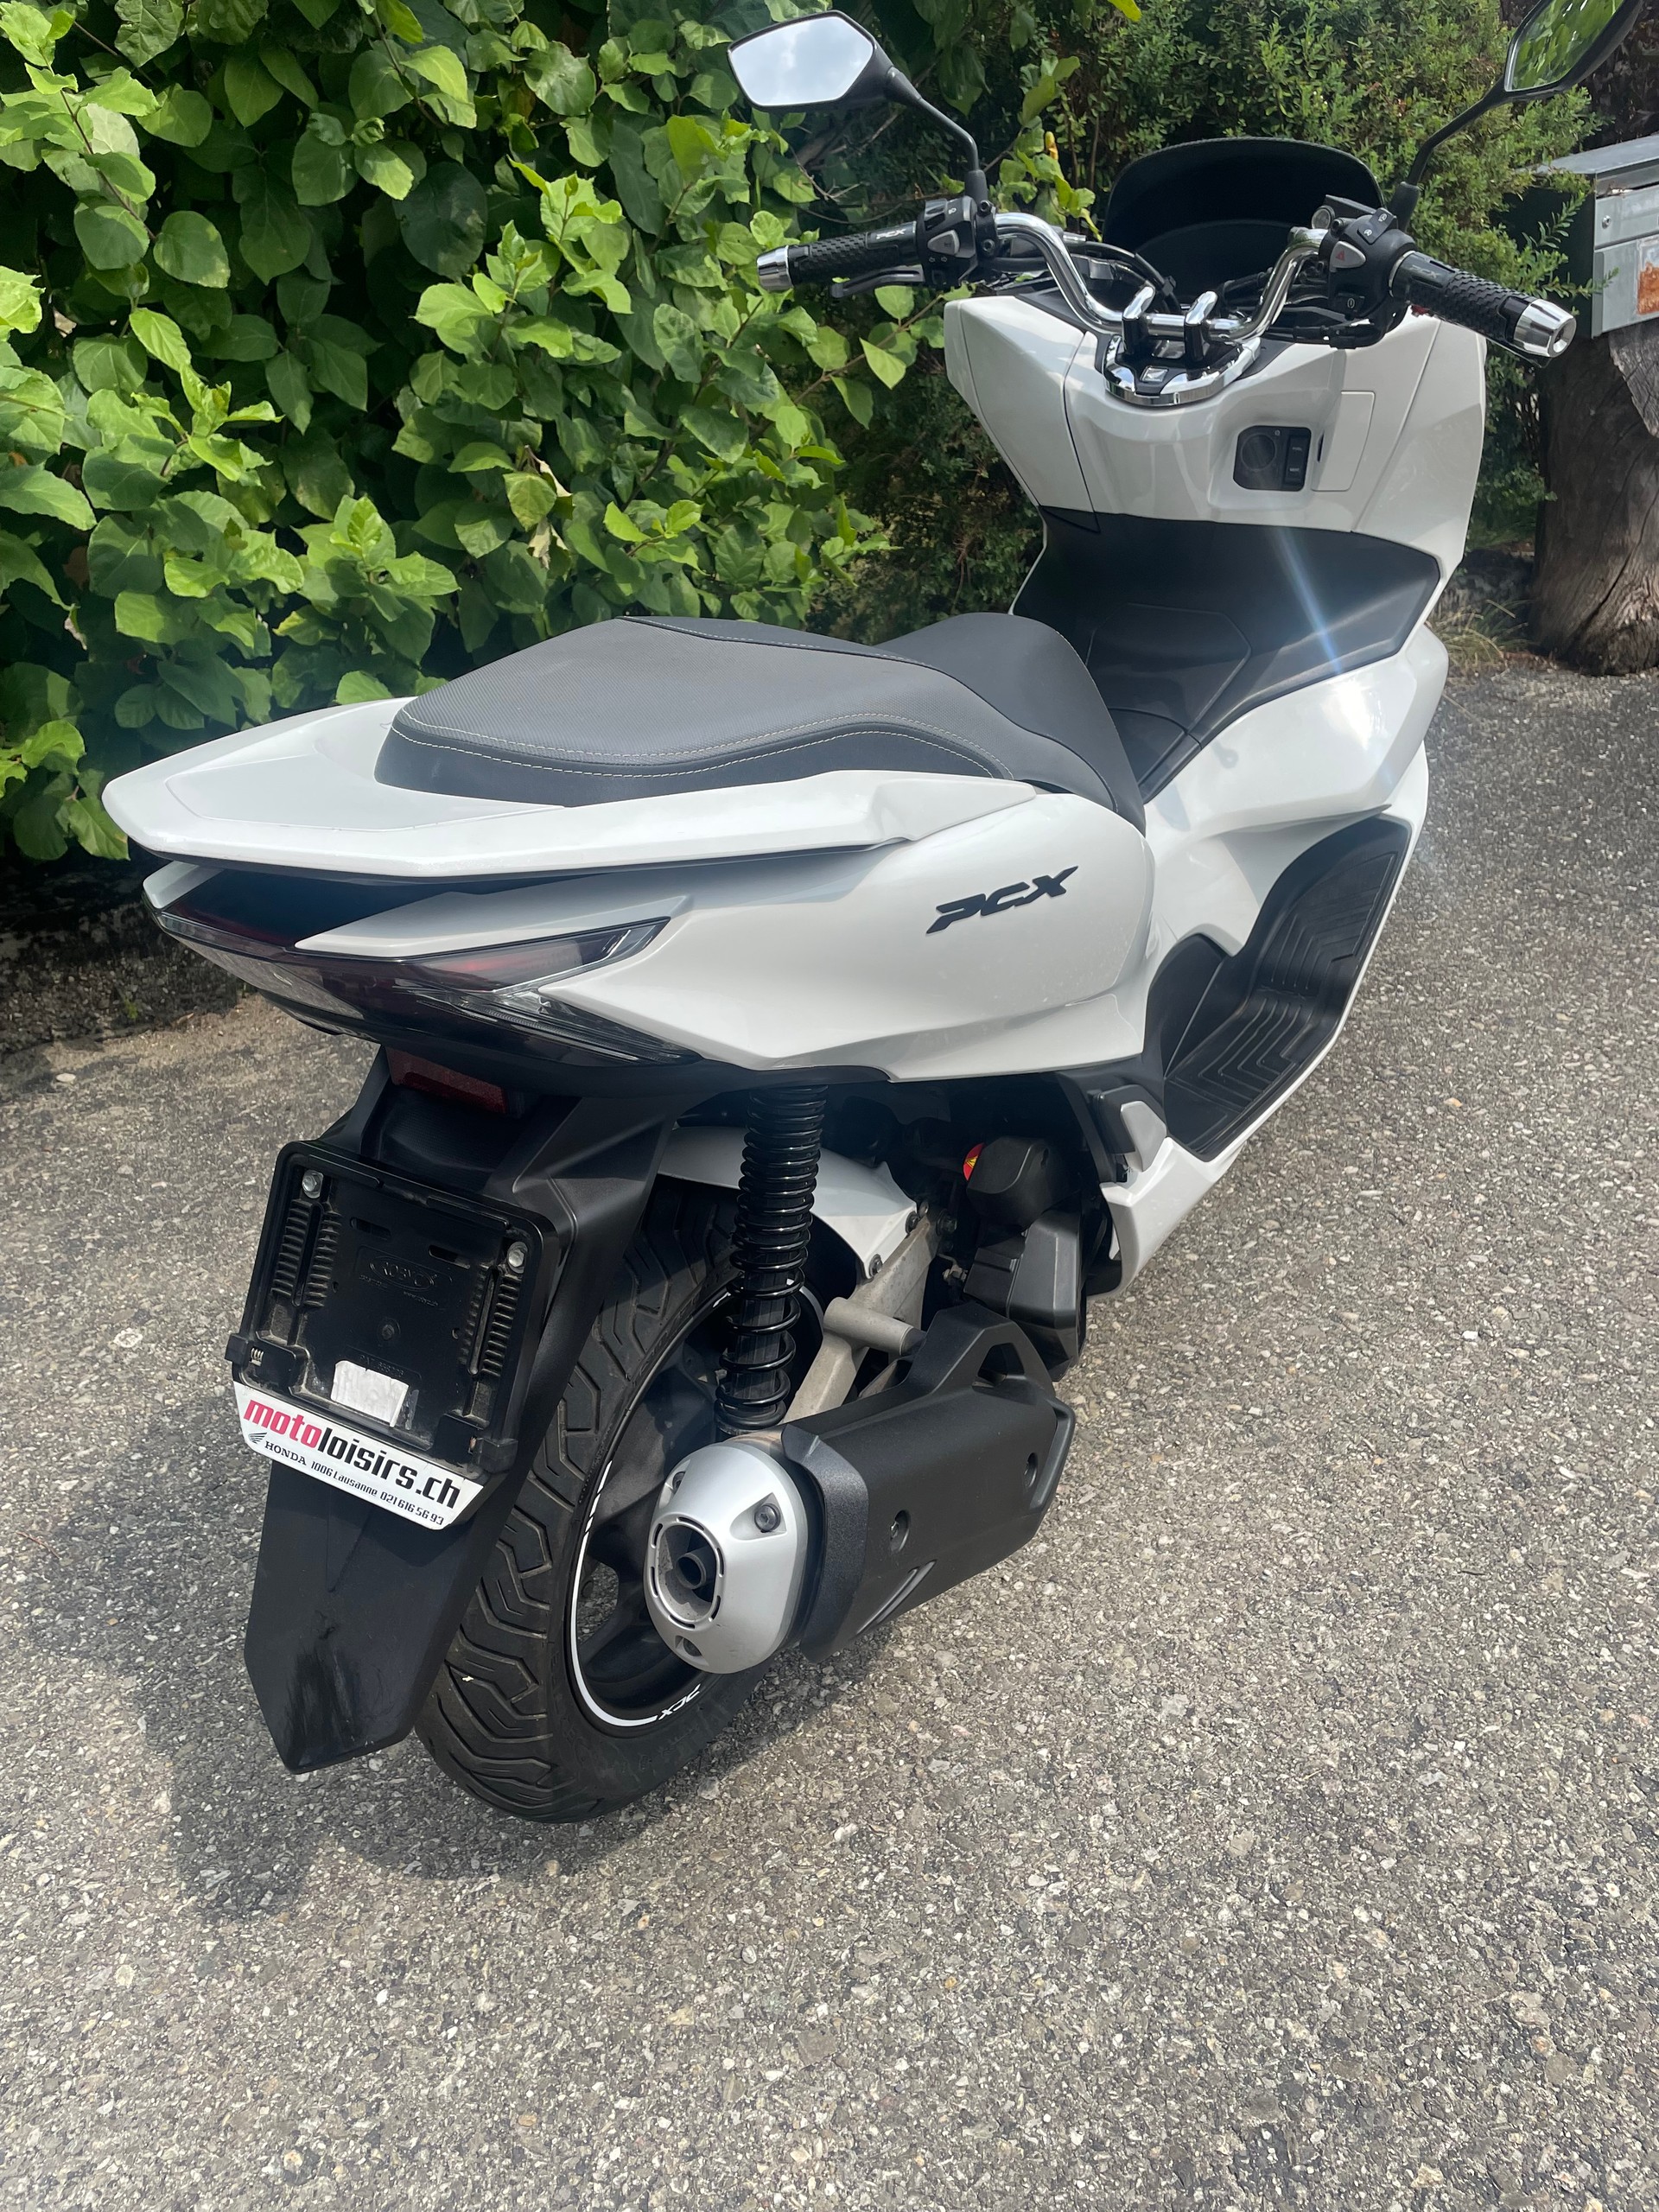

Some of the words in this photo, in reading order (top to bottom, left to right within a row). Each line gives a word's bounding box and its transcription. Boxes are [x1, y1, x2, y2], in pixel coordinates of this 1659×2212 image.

[876, 228, 906, 239] PCX
[926, 866, 1078, 933] PCX
[244, 1400, 461, 1508] motoloisirs.ch
[264, 1440, 307, 1465] HONDA
[311, 1461, 334, 1477] 1006
[333, 1471, 378, 1497] Lausanne
